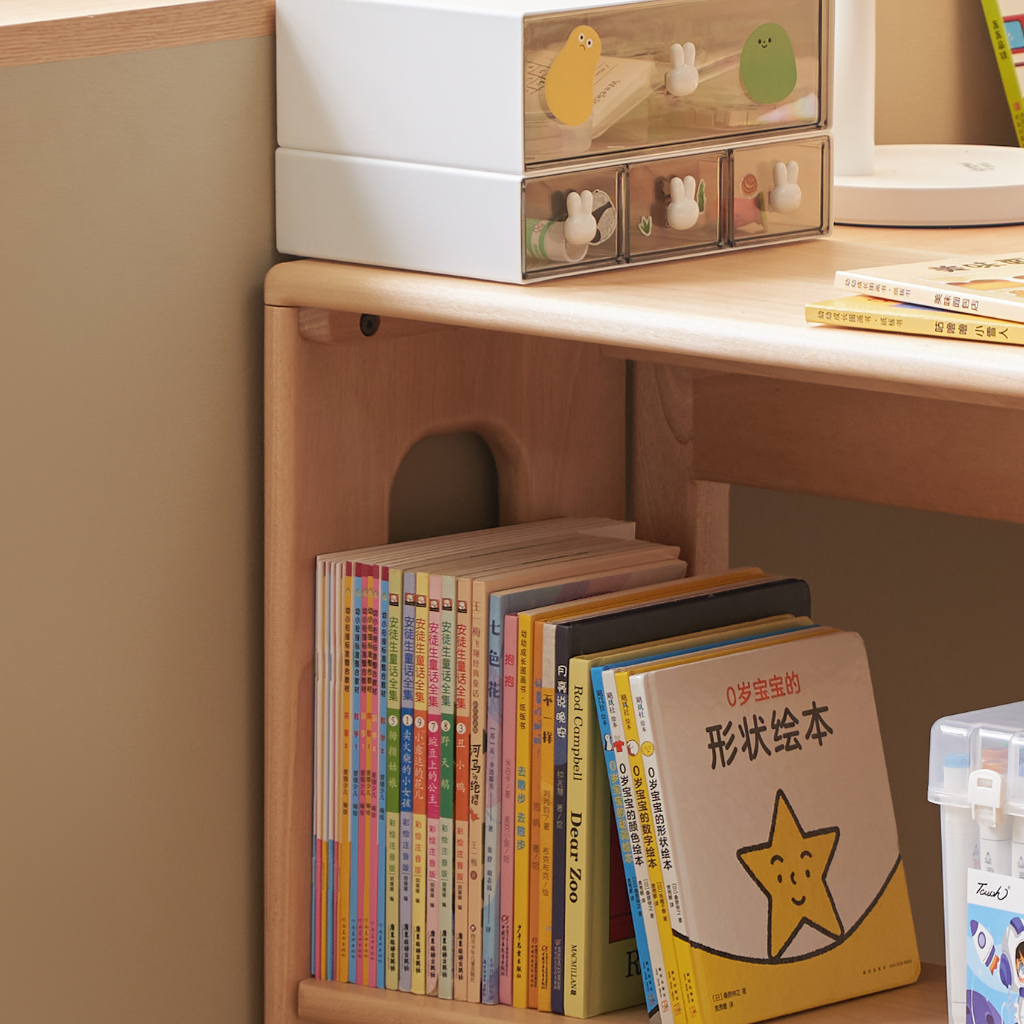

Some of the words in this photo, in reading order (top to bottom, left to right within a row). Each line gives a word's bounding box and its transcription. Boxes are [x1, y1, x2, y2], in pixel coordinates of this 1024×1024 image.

[934, 293, 980, 312] 美味面包店
[974, 324, 1009, 340] 小雪人
[388, 616, 399, 702] 安徒生童话全集
[403, 616, 415, 701] 安徒生童话全集
[415, 618, 426, 703] 安徒生童话全集
[428, 622, 439, 707] 安徒生童话全集
[441, 621, 452, 706] 安徒生童话全集
[456, 623, 467, 709] 安徒生童话全集
[472, 601, 481, 698] 王一梅飞翔经典童话
[488, 619, 501, 698] 七色花
[504, 653, 515, 688] 抱抱
[519, 629, 527, 729] 幼幼成长图画书·纸板书
[556, 664, 568, 739] 月亮说晚安
[573, 685, 584, 711] Rod
[726, 671, 801, 707] 0岁宝宝的
[542, 693, 553, 744] 不一样
[705, 700, 834, 770] 形状绘本
[388, 731, 398, 788] 拇指姑娘
[401, 730, 412, 808] 卖火柴的小女孩
[414, 733, 425, 800] 小意达的花儿
[428, 737, 438, 805] 豌豆上的公主
[440, 736, 450, 790] 野天鹅
[456, 739, 466, 793] 丑小鸭
[470, 744, 481, 805] 河马的绝招
[571, 716, 583, 781] Campbell
[517, 766, 526, 804] 去散步
[516, 812, 526, 850] 去散步
[569, 811, 583, 862] Dear
[619, 763, 645, 867] 0岁宝宝的颜色绘本
[633, 765, 658, 869] 0岁宝宝的数字绘本
[648, 767, 673, 871] 0岁宝宝的形状绘本
[388, 819, 396, 873] 彩绘注音版
[402, 818, 410, 872] 彩绘注音版
[414, 820, 422, 875] 彩绘注音版
[428, 825, 436, 879] 彩绘注音版
[441, 824, 449, 878] 彩绘注音版
[456, 827, 464, 881] 彩绘注音版
[569, 867, 582, 903] Zoo
[570, 944, 578, 989] MACMILLAN
